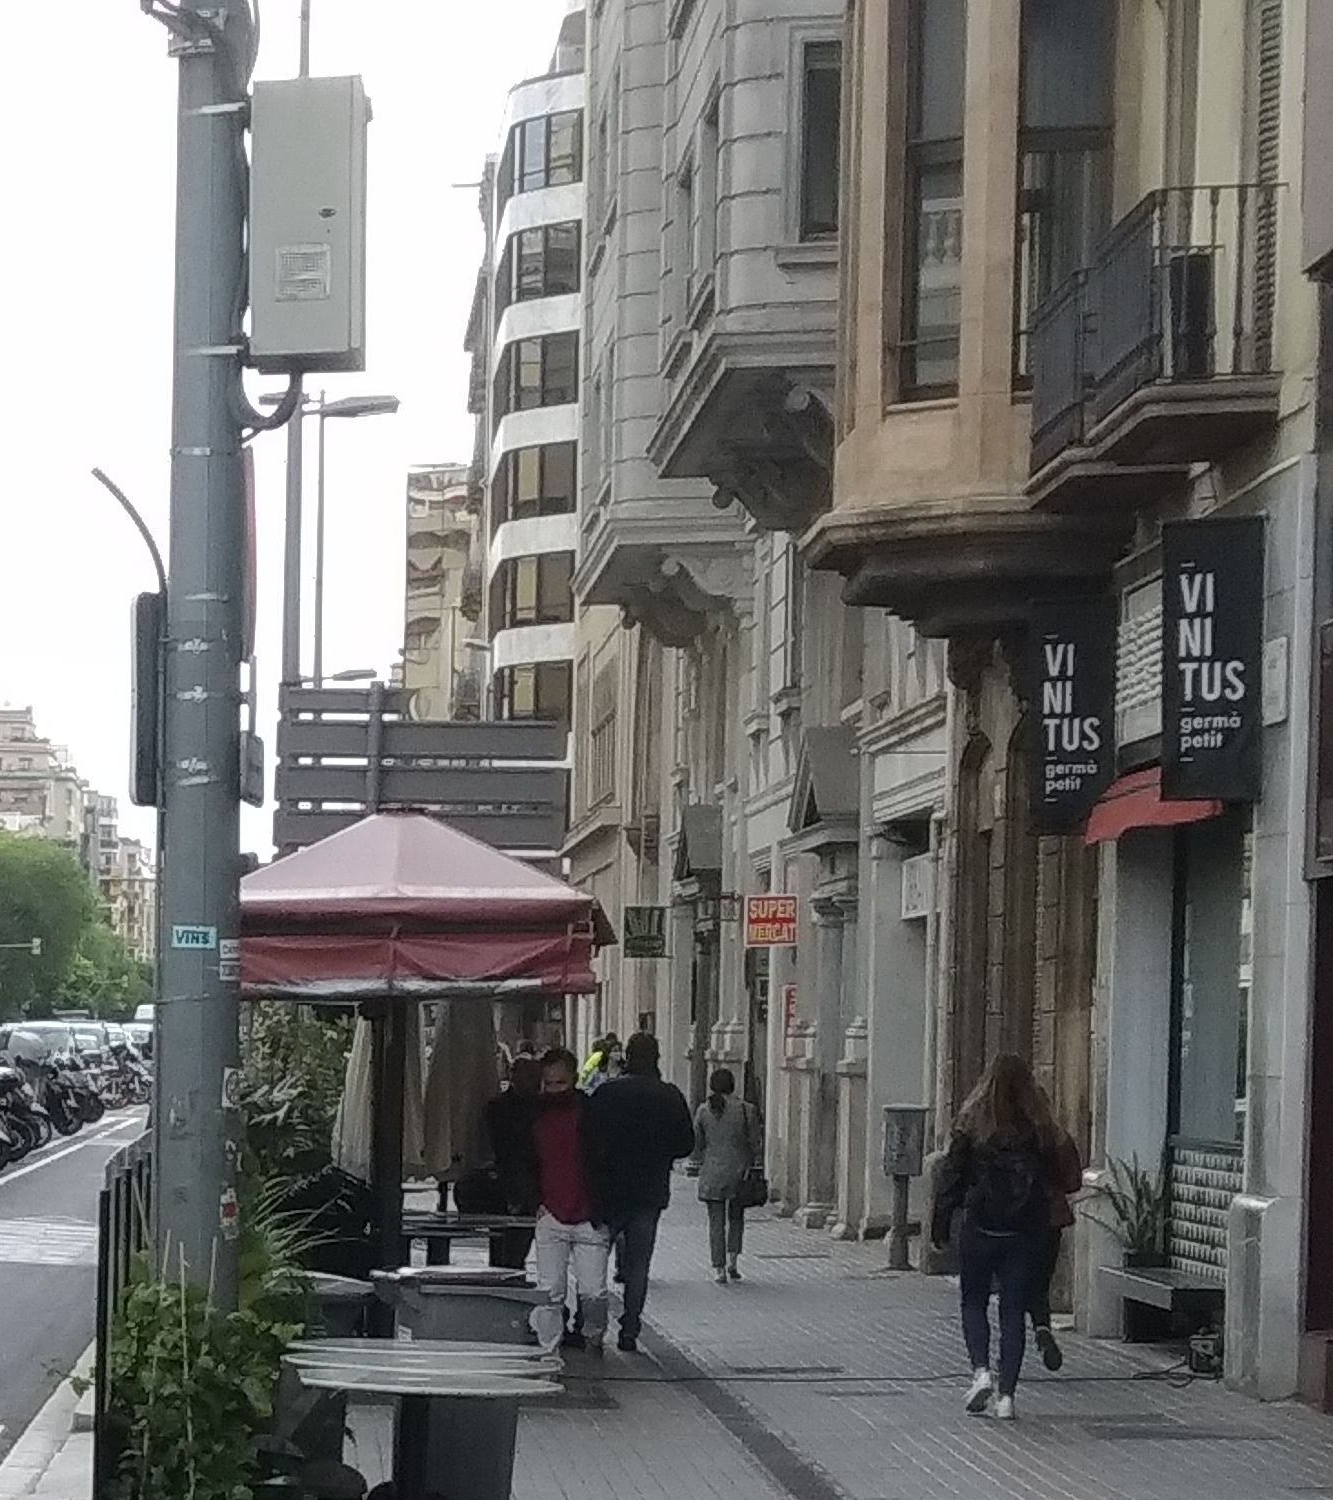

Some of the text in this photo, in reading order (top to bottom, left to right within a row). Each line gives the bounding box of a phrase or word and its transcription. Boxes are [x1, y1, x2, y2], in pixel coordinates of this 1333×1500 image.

[1180, 572, 1214, 613] VI
[1178, 616, 1212, 657] NI
[1044, 644, 1075, 677] VI
[1043, 680, 1073, 714] NI
[1179, 660, 1245, 702] TUS
[1043, 717, 1101, 751] TUS
[1180, 730, 1223, 753] petit
[1045, 776, 1081, 795] petit
[749, 900, 796, 919] SUPER
[748, 923, 796, 942] MERCAT
